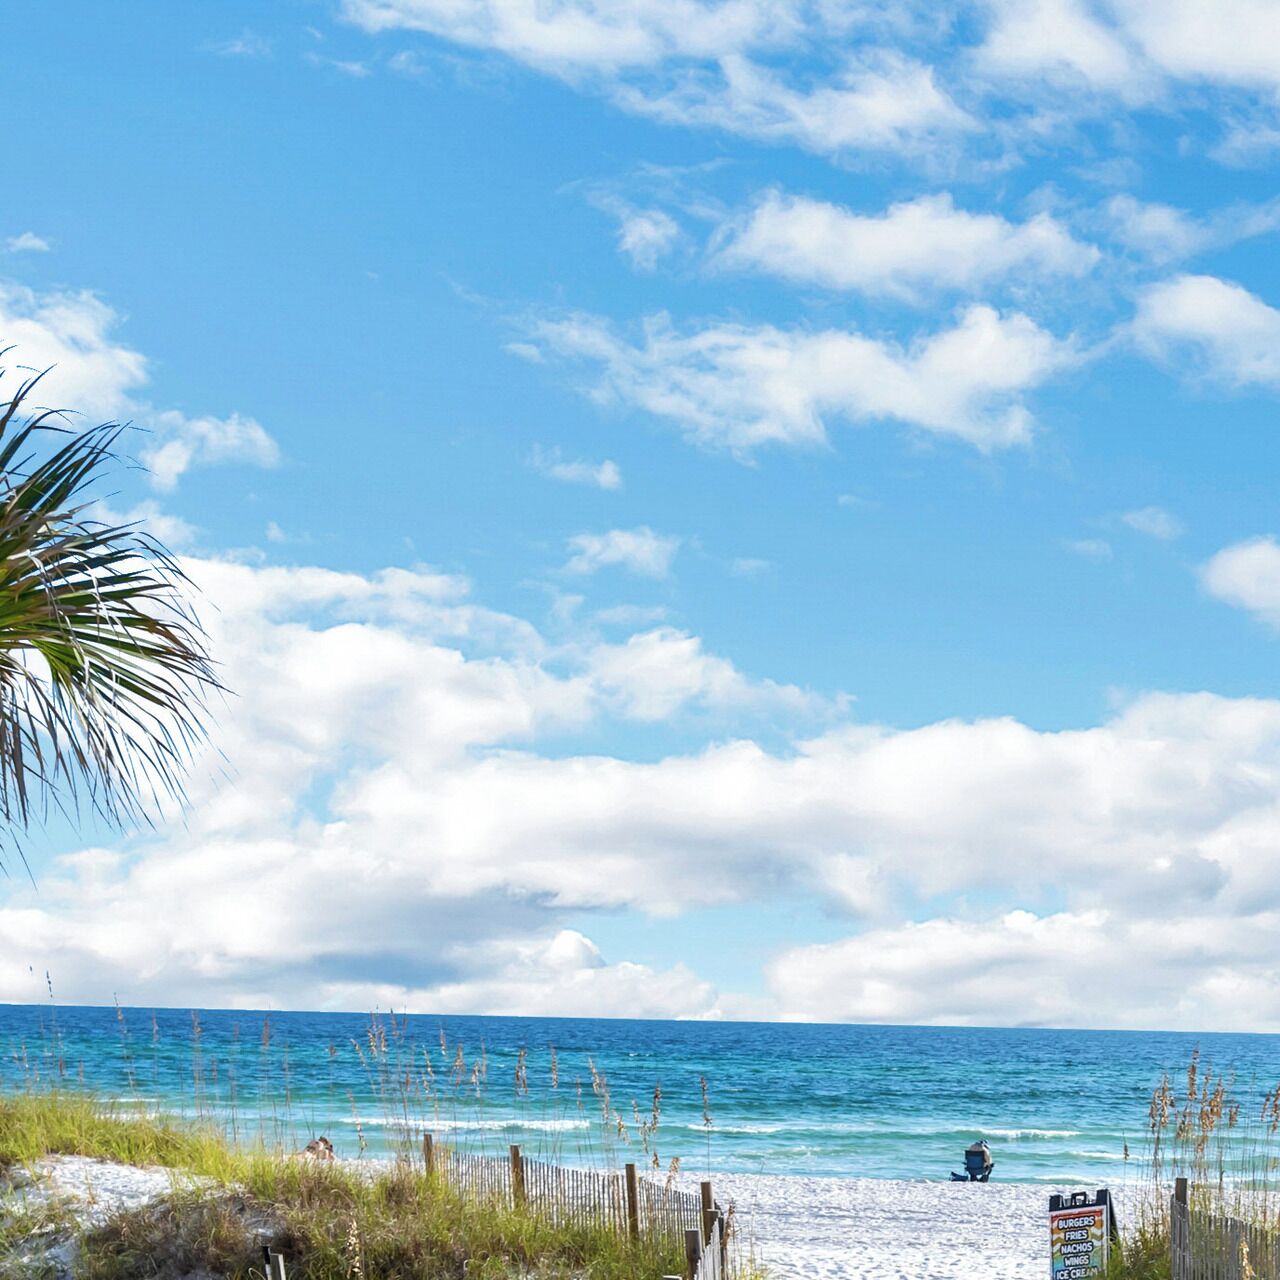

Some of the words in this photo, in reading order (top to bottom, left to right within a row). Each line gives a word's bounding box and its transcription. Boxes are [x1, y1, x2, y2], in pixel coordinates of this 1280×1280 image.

[1058, 1216, 1095, 1229] BURGERS
[1065, 1230, 1088, 1241] FRIES
[1061, 1242, 1093, 1254] NACHOS
[1064, 1255, 1089, 1267] WINGS
[1056, 1270, 1069, 1280] ICE
[1070, 1267, 1098, 1279] CREAM
